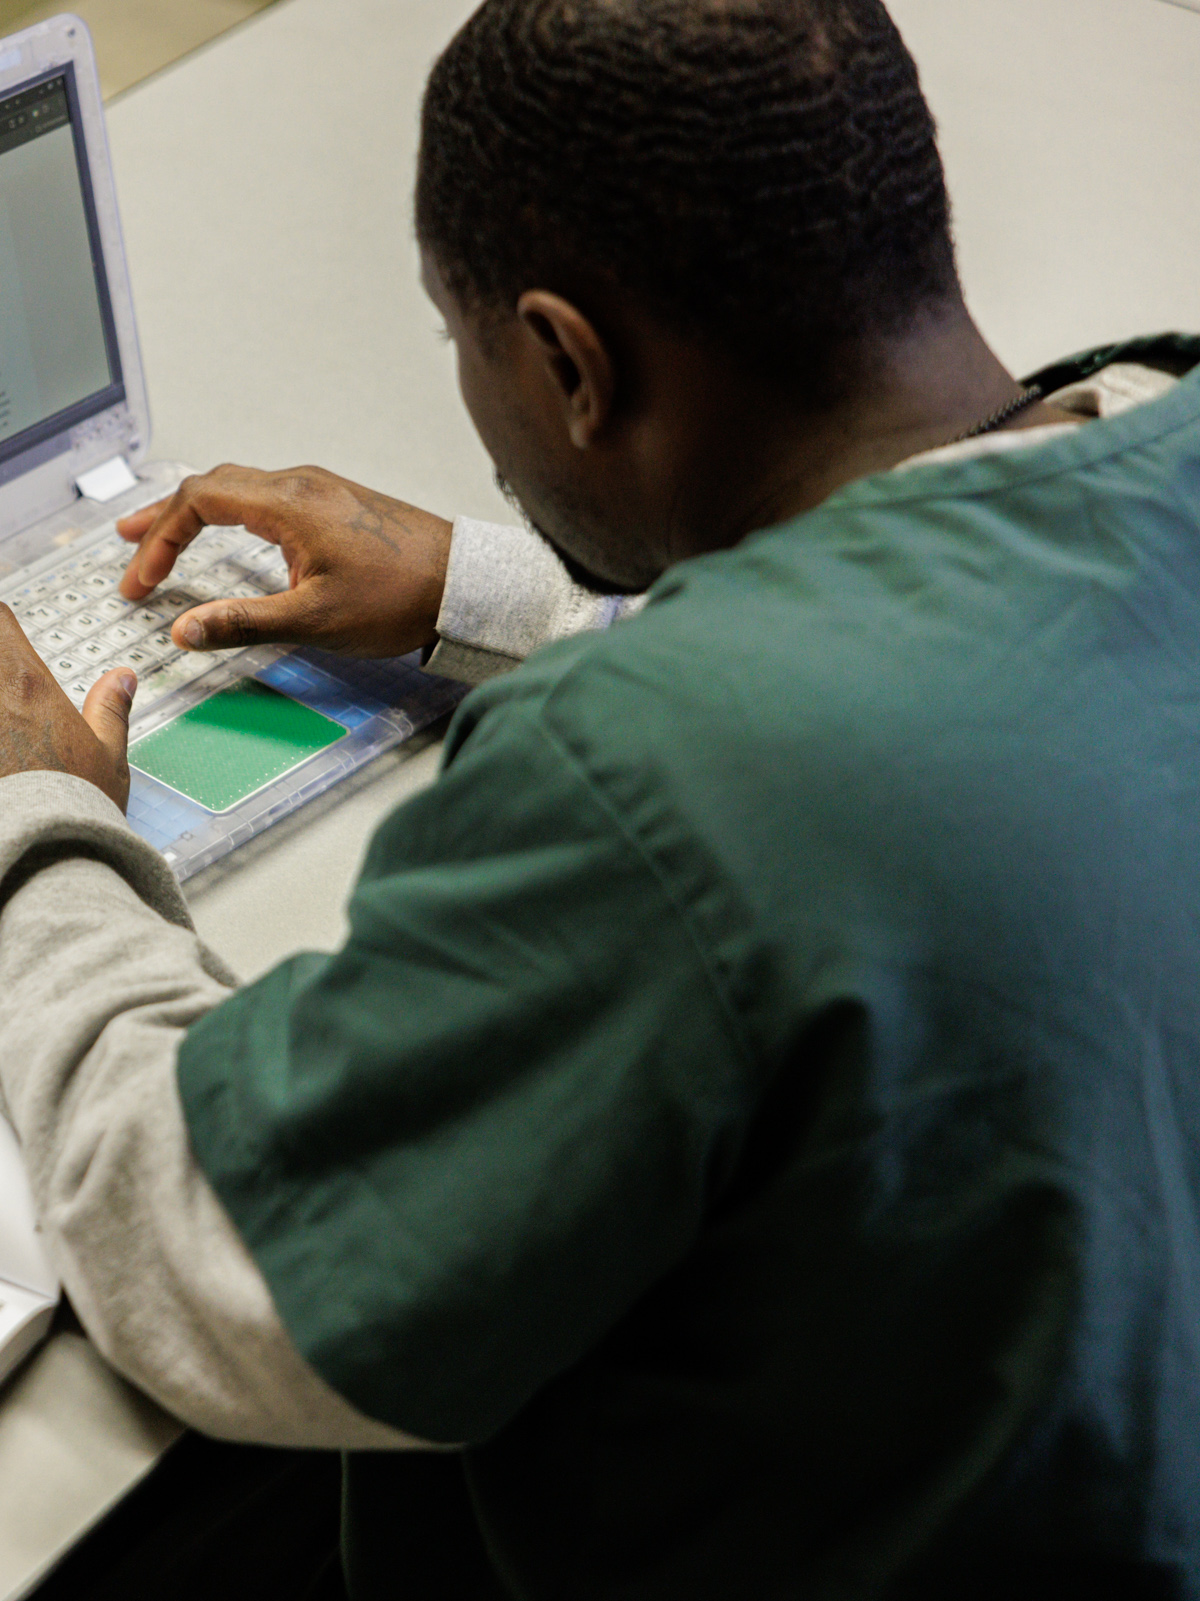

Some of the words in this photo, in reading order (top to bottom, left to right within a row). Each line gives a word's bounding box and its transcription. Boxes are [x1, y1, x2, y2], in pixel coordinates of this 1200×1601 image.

[79, 616, 92, 625] U
[50, 633, 63, 641] Y
[86, 644, 100, 654] H
[129, 652, 143, 662] N
[59, 661, 72, 669] G
